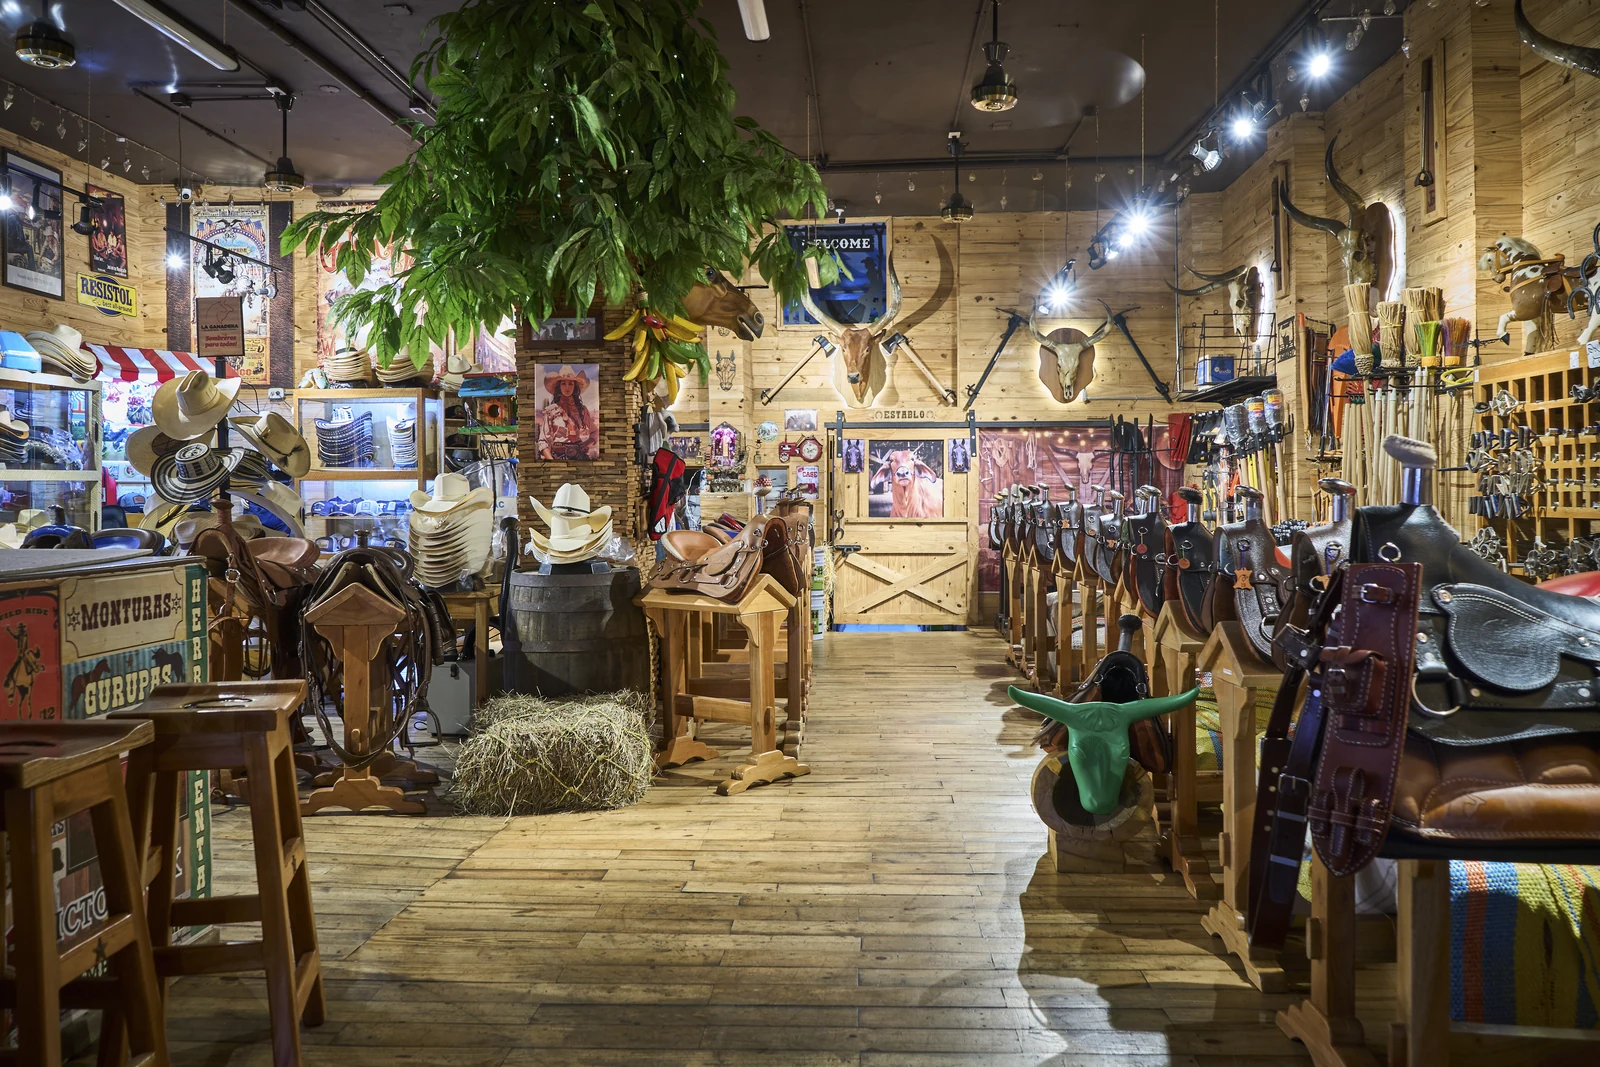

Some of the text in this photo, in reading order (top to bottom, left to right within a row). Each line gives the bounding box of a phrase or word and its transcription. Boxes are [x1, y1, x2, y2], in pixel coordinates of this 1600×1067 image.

[801, 238, 871, 249] ELCOME
[80, 276, 133, 307] RESISTOL
[883, 410, 925, 419] ESTABLO
[25, 608, 49, 616] RIDE
[81, 592, 172, 631] MONTURAS
[84, 663, 172, 716] GURUPAS
